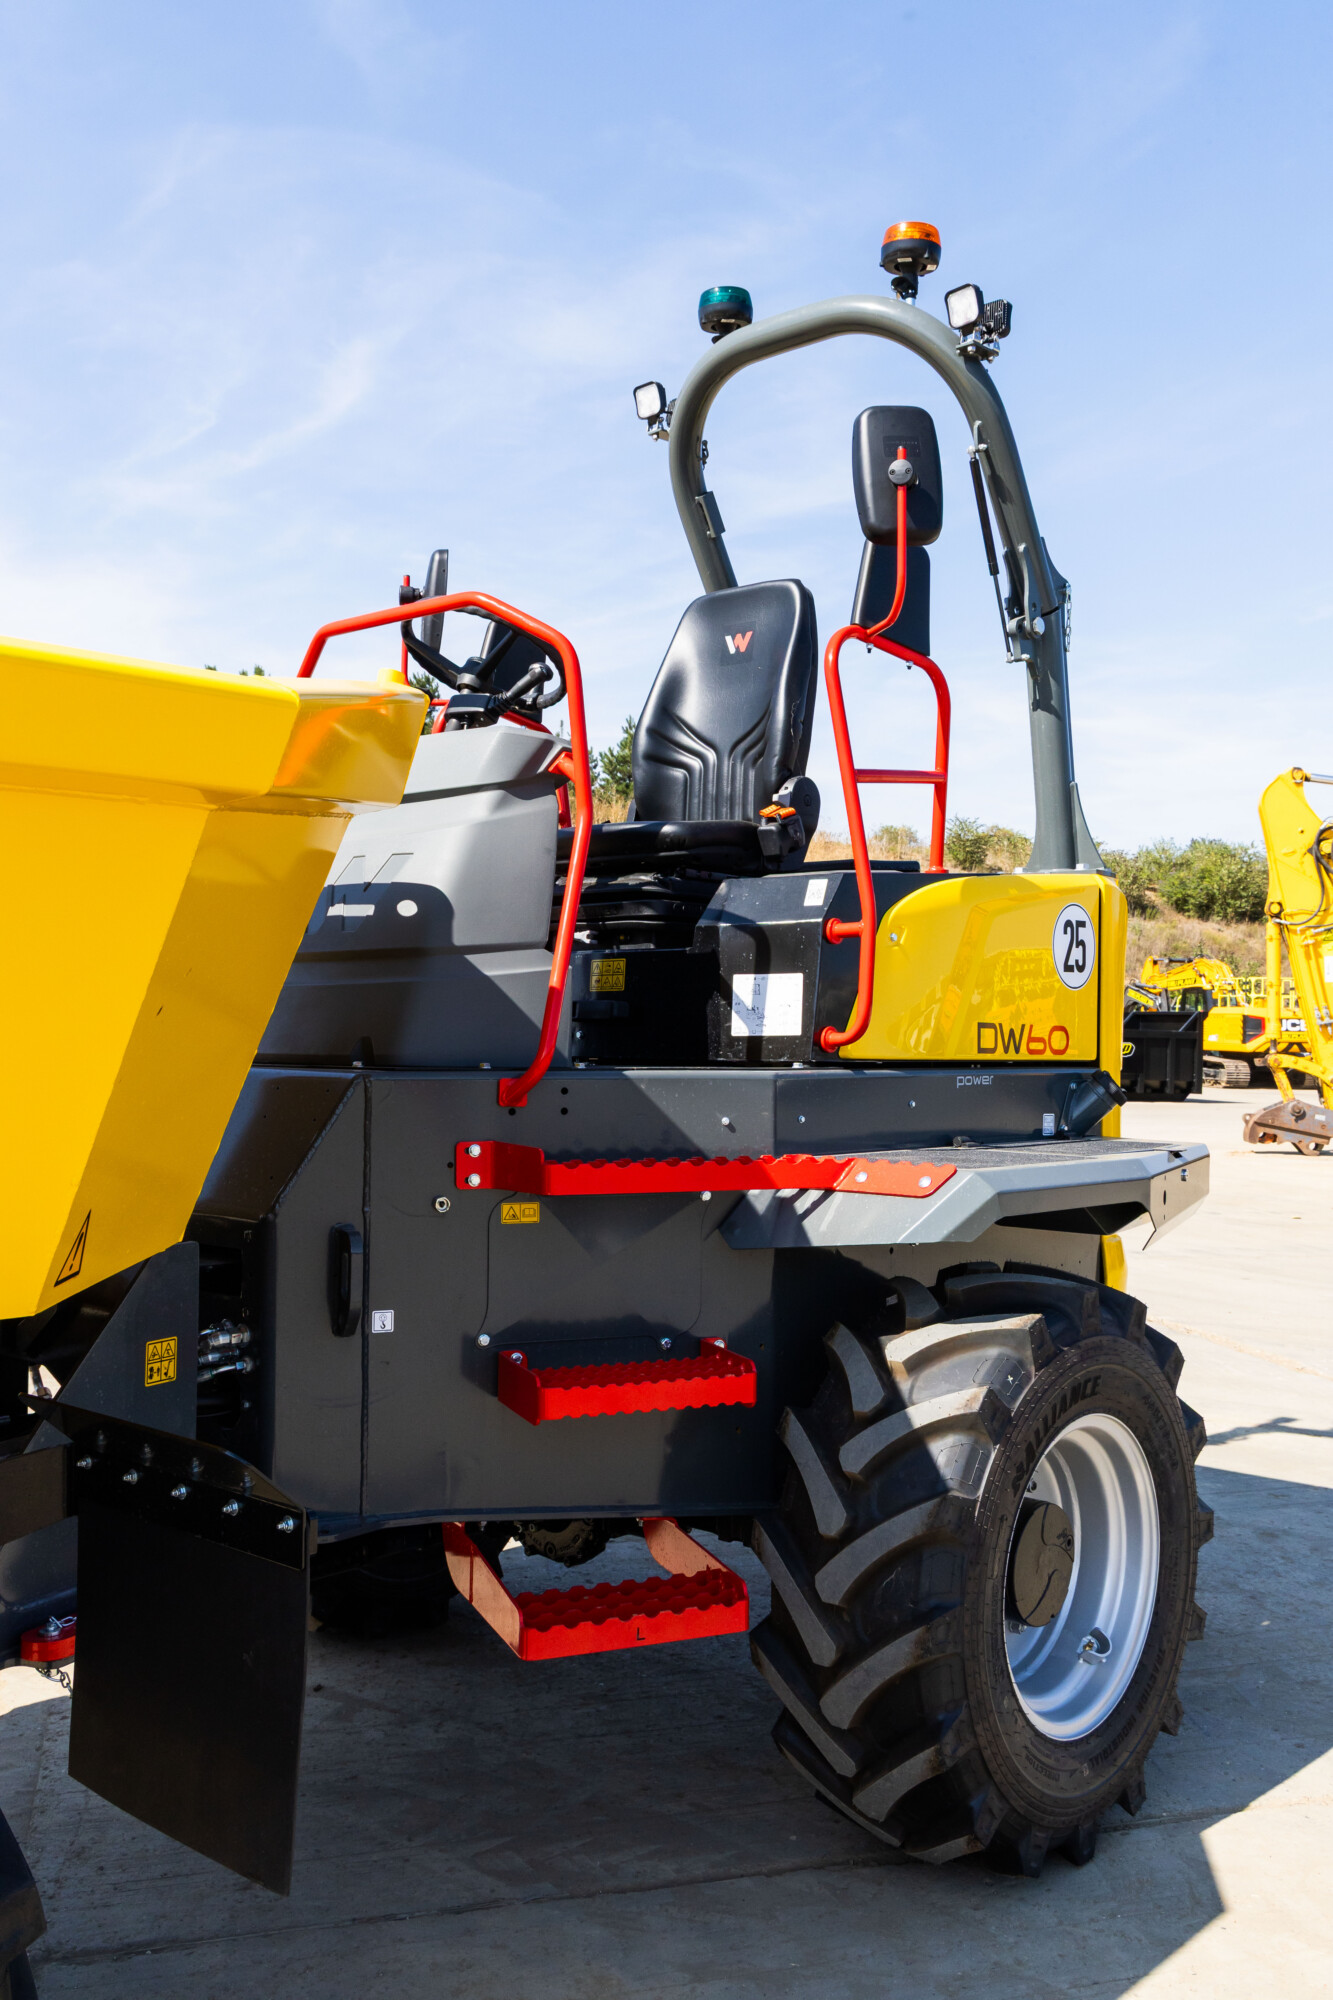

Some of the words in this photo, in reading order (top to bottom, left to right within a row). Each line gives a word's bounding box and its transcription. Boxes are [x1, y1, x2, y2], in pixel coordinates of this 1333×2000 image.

[1063, 919, 1086, 973] 25
[977, 1021, 1070, 1056] DW60
[956, 1075, 994, 1089] power
[636, 1626, 646, 1641] L
